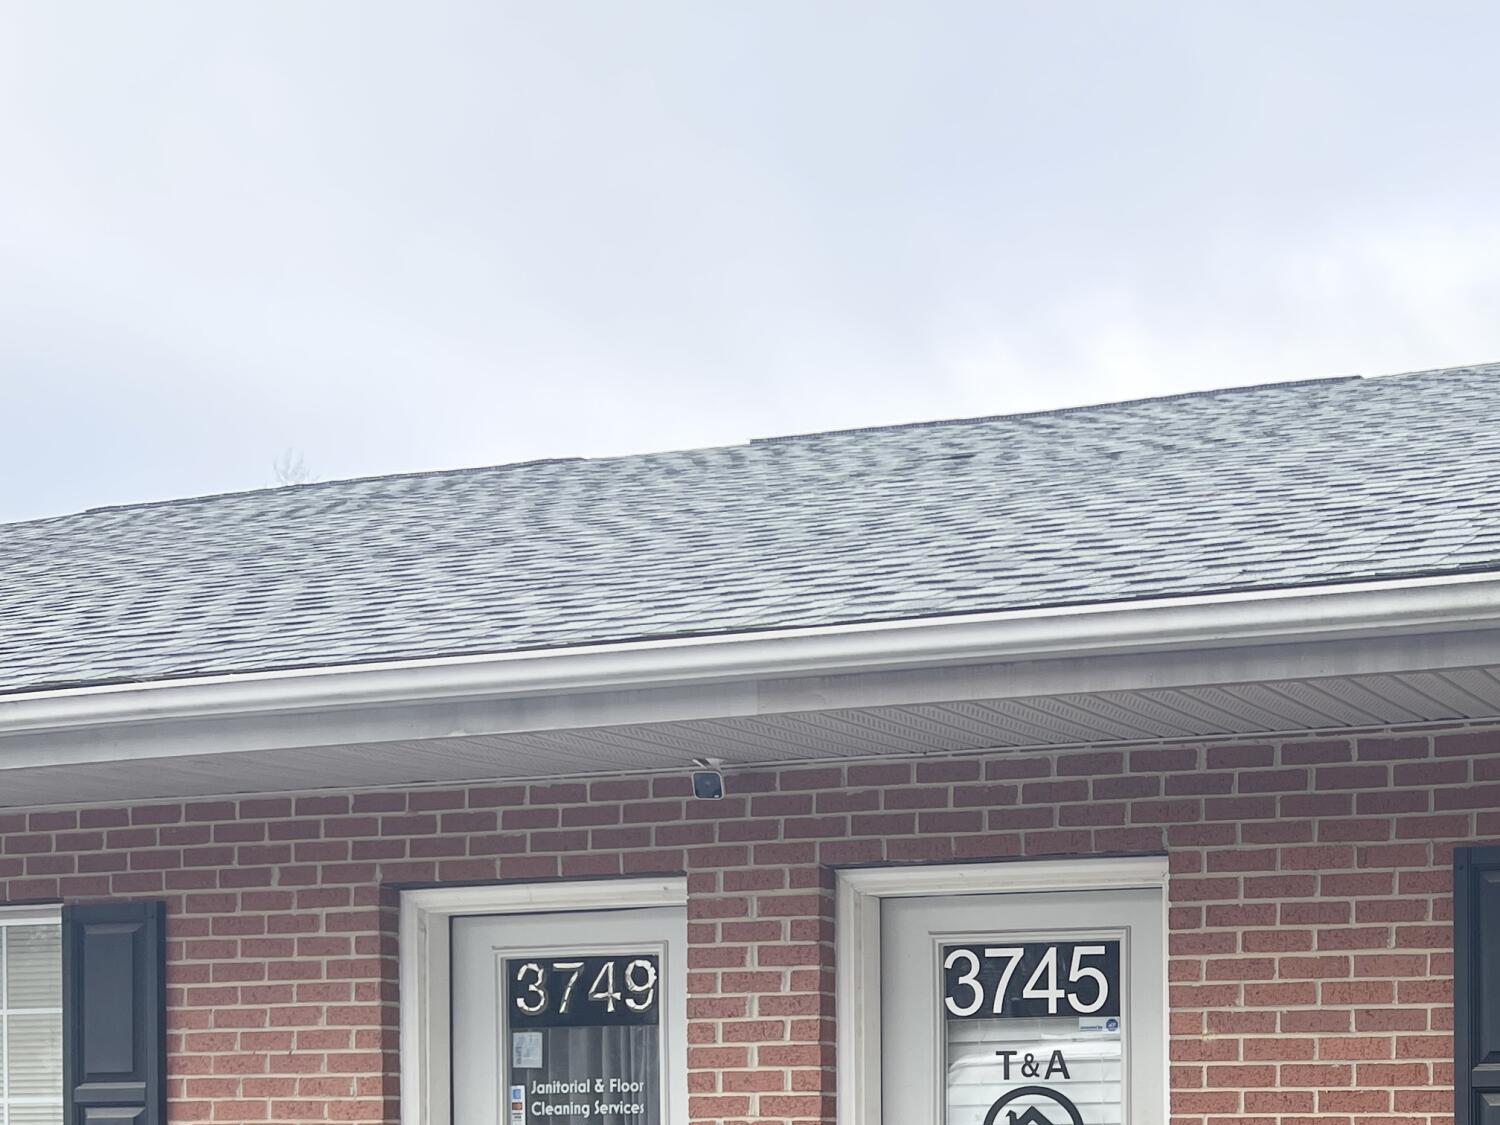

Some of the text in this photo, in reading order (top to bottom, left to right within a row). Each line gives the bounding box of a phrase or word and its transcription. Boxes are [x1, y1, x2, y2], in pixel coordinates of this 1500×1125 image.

[516, 959, 658, 1016] 3749
[944, 946, 1108, 1017] 3745
[531, 1078, 645, 1095] Janitorial & Floor
[531, 1100, 646, 1118] Cleaning Services
